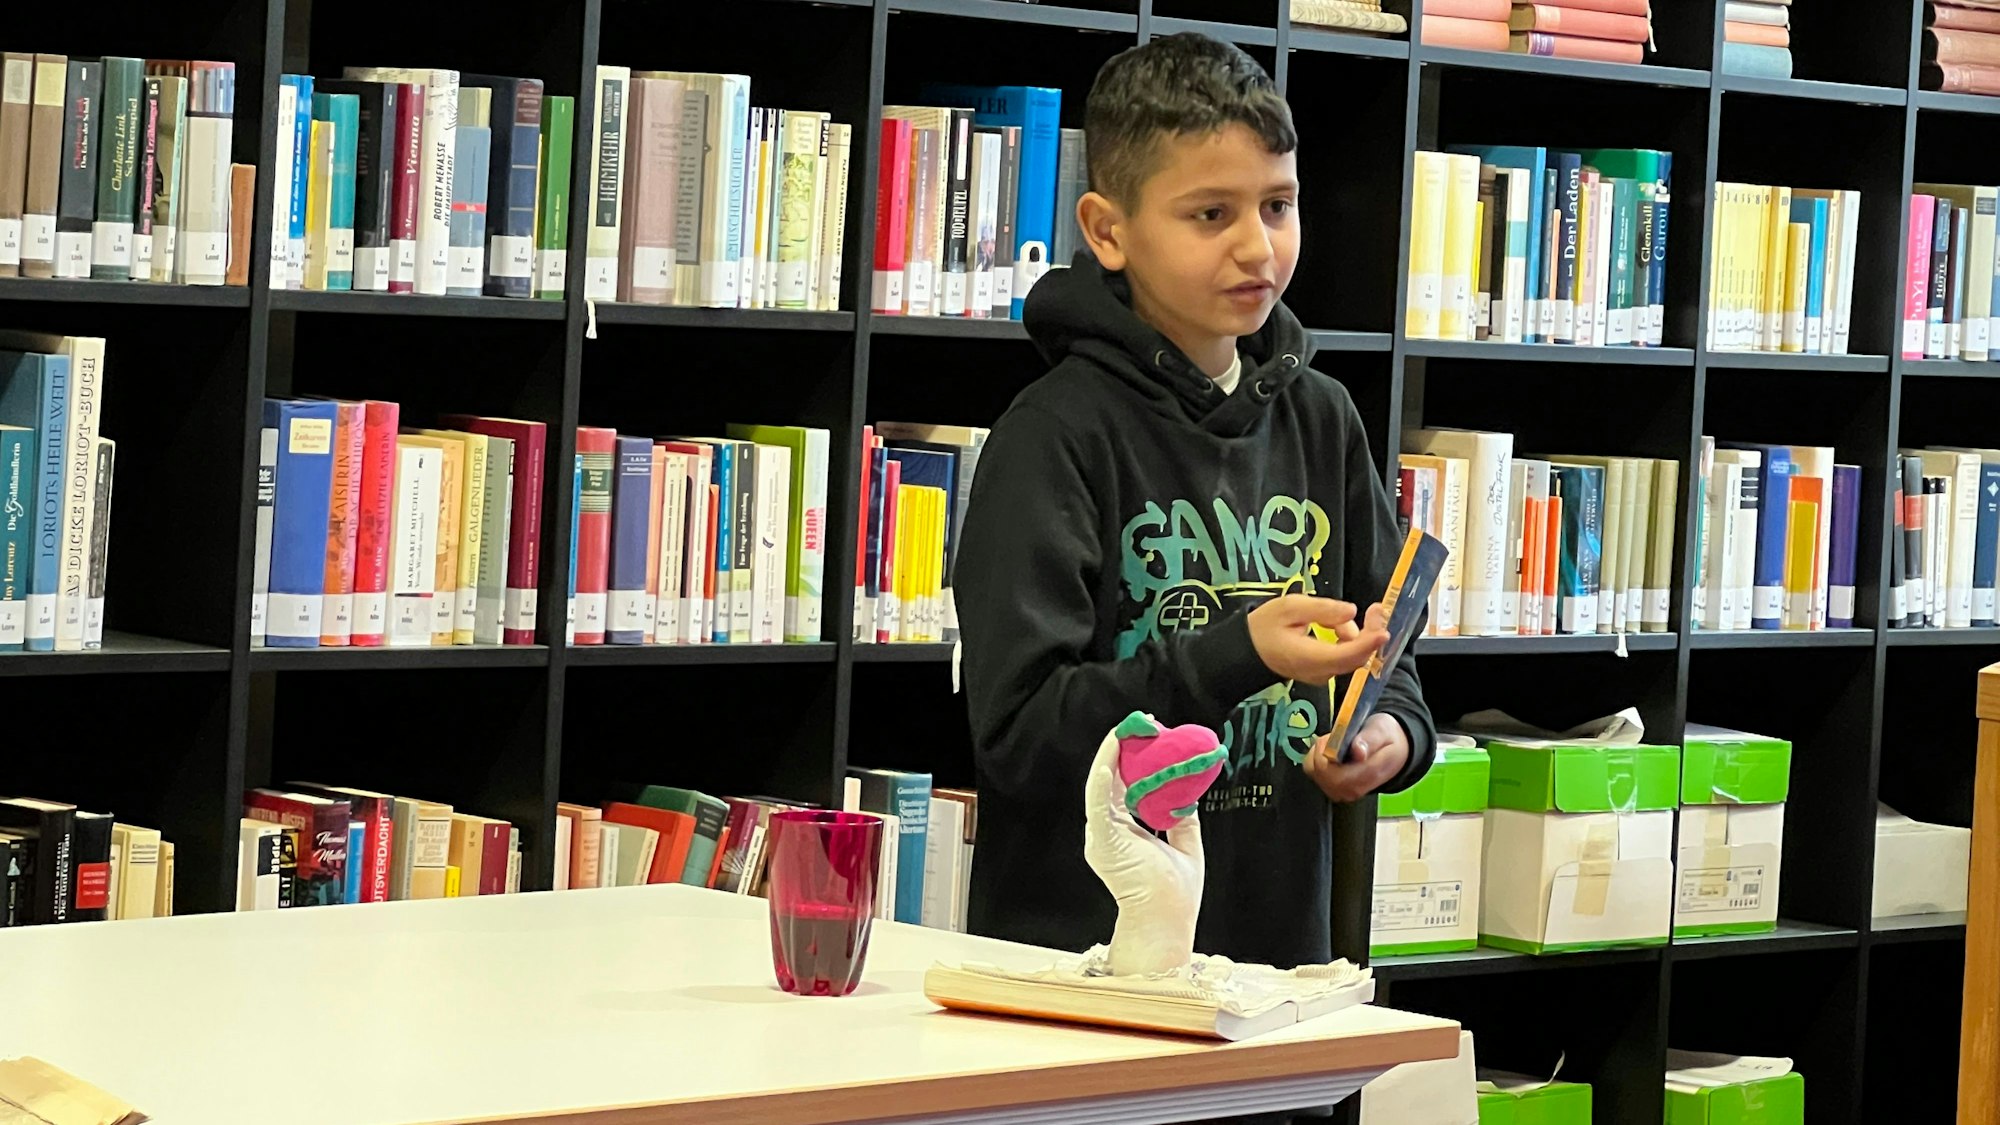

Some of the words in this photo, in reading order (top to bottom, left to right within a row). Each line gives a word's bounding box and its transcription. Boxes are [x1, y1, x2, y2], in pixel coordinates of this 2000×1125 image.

[116, 114, 126, 140] Link
[124, 98, 138, 177] Schattenspiel
[406, 115, 420, 175] Vienna
[820, 121, 830, 156] PIPER
[112, 143, 123, 191] Charlotte
[436, 142, 446, 182] MENASSE
[445, 155, 454, 213] HAUPTSTADT
[600, 131, 619, 201] HEIMKEHR
[434, 185, 443, 221] ROBERT
[952, 189, 967, 219] TEUFEL
[1565, 168, 1580, 223] Laden
[952, 221, 965, 240] TOD
[1564, 225, 1576, 259] Der
[1641, 205, 1653, 263] Glennkill
[1654, 207, 1668, 261] Garou
[50, 370, 66, 421] WELT
[46, 424, 62, 475] HEILE
[72, 357, 95, 503] LORIOT-BUCH
[5, 443, 23, 515] Goldhändlerin
[333, 455, 351, 524] KAISERIN
[348, 419, 364, 539] DRACHENTHRON
[410, 478, 419, 531] MITCHELL
[469, 447, 483, 543] GALGENLIEDER
[1486, 480, 1496, 505] DER
[7, 515, 17, 531] Die
[42, 480, 58, 558] LORIOTs
[66, 507, 85, 570] DICKE
[804, 508, 818, 551] QUEEN
[1449, 480, 1461, 549] PLANTAGE
[4, 541, 15, 582] Lorentz
[407, 533, 416, 588] MARGARET
[1448, 553, 1456, 578] DIE
[1485, 535, 1495, 580] DONNA
[61, 833, 70, 858] Frau
[270, 837, 281, 873] PIPER
[280, 877, 291, 907] EXIT
